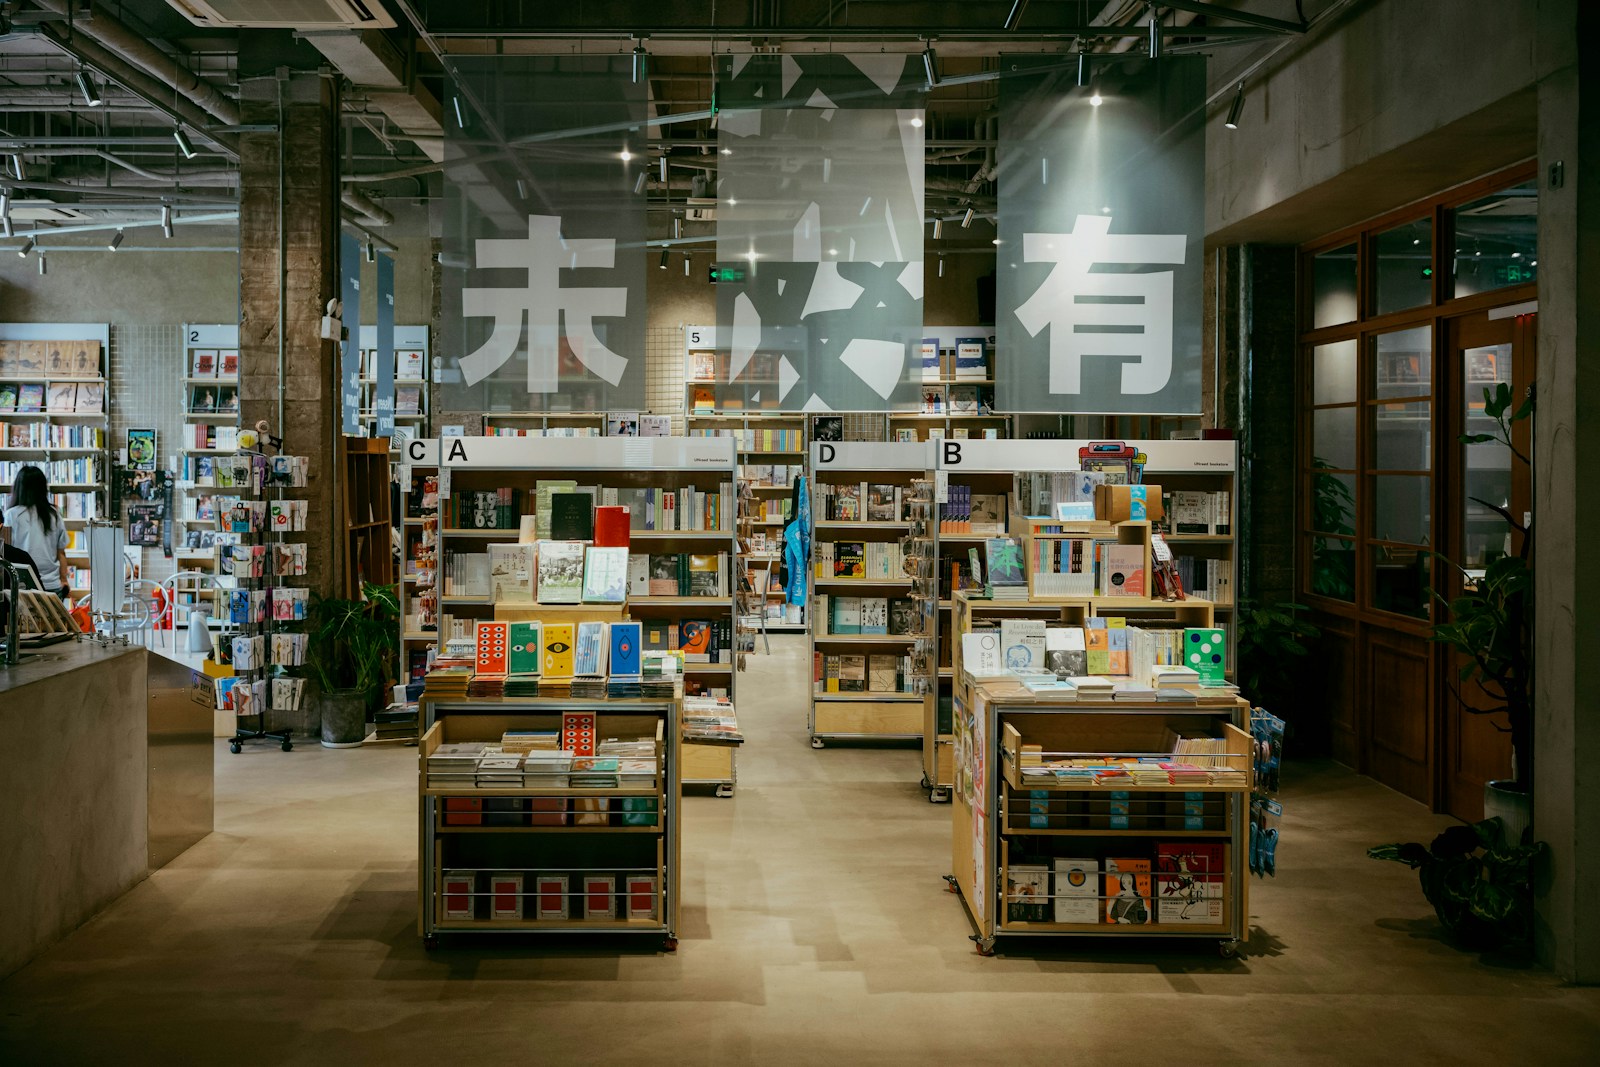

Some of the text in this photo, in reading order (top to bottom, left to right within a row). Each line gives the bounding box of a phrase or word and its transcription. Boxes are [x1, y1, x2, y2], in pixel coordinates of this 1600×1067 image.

[458, 214, 630, 393] 未
[1014, 215, 1186, 395] 有
[190, 331, 199, 342] 2
[691, 332, 700, 343] 5
[409, 441, 426, 461] C
[448, 439, 468, 461] A
[819, 444, 836, 463] D
[944, 442, 962, 465] B
